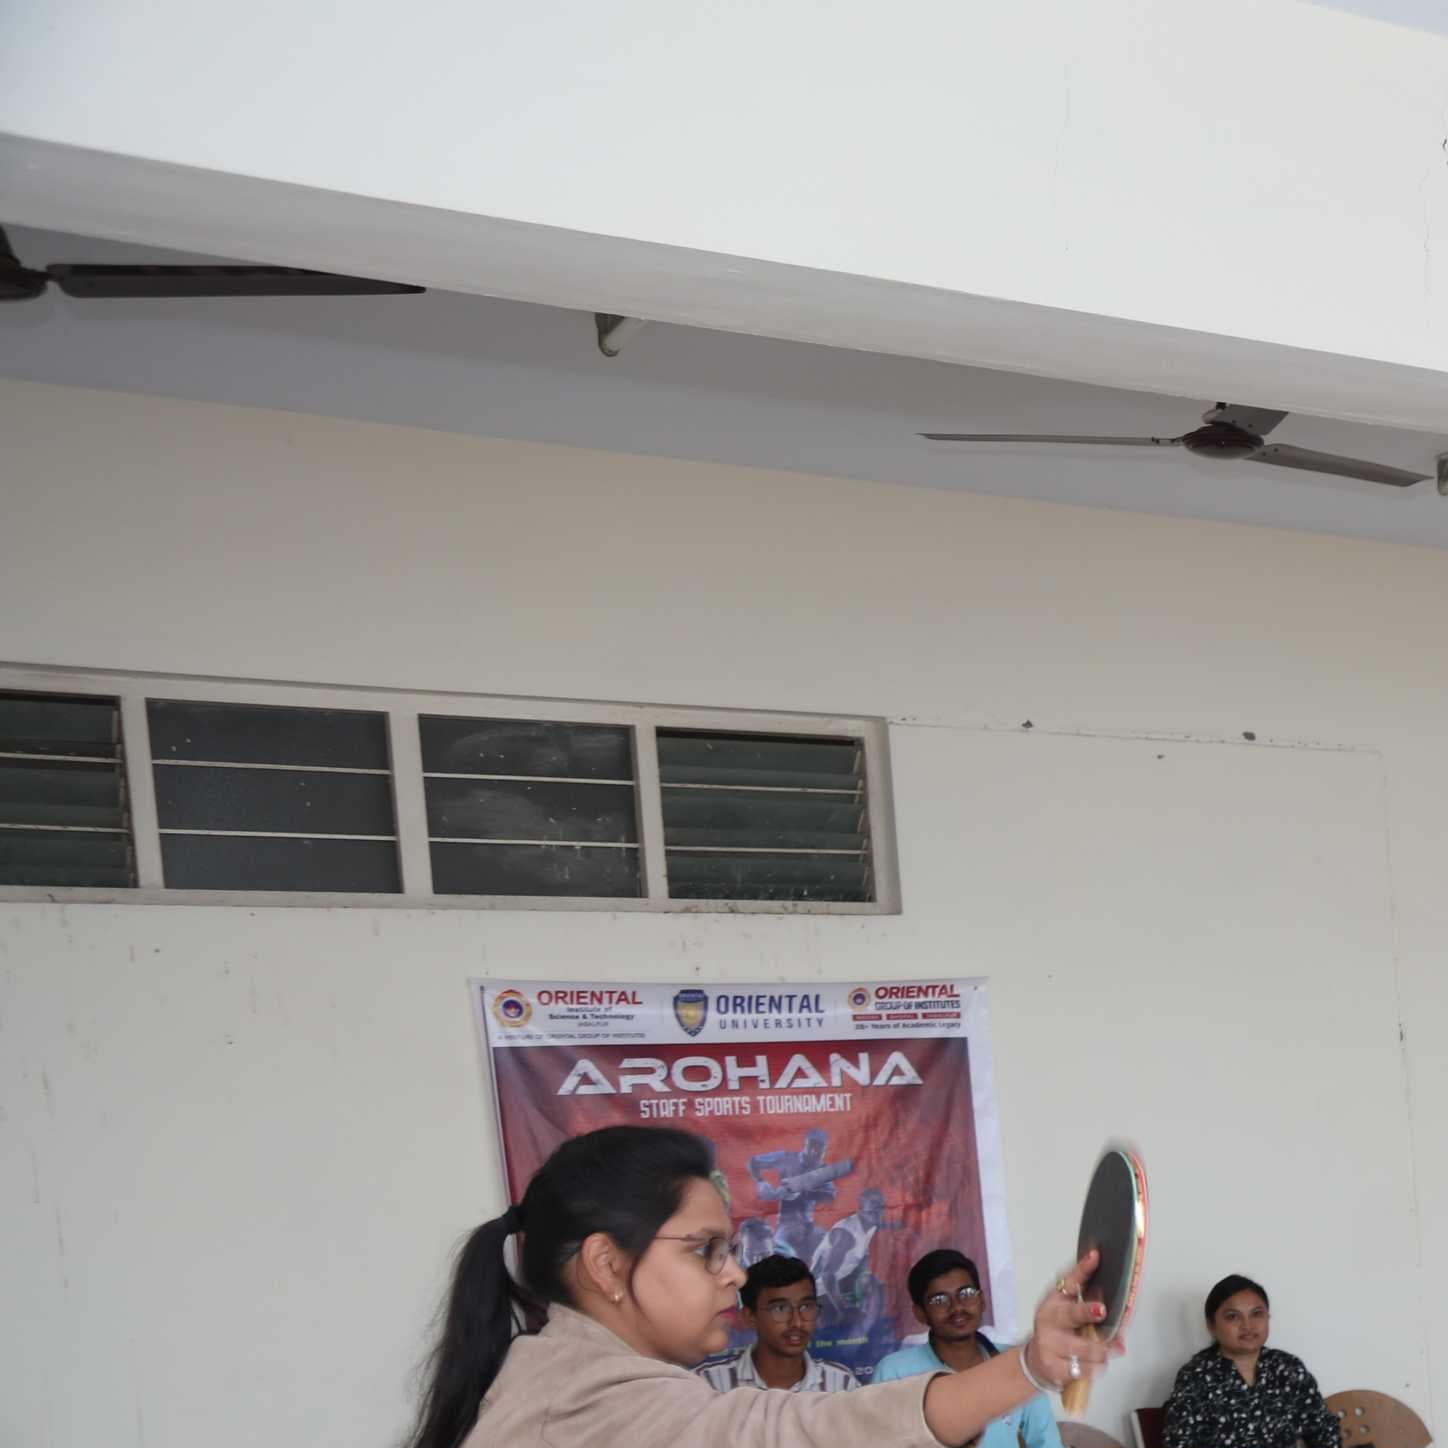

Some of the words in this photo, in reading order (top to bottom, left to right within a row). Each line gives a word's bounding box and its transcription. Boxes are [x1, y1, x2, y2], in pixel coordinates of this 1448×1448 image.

[537, 989, 643, 1006] ORIENTAL
[874, 984, 961, 1000] ORIENTAL
[716, 993, 825, 1015] ORIENTAL
[591, 1013, 635, 1021] Technology
[719, 1017, 825, 1030] UNIVERSITY
[556, 1050, 924, 1096] AROHANA
[639, 1097, 688, 1119] STAFF
[695, 1096, 751, 1117] SPORTS
[756, 1093, 853, 1116] TOURNAMENT
